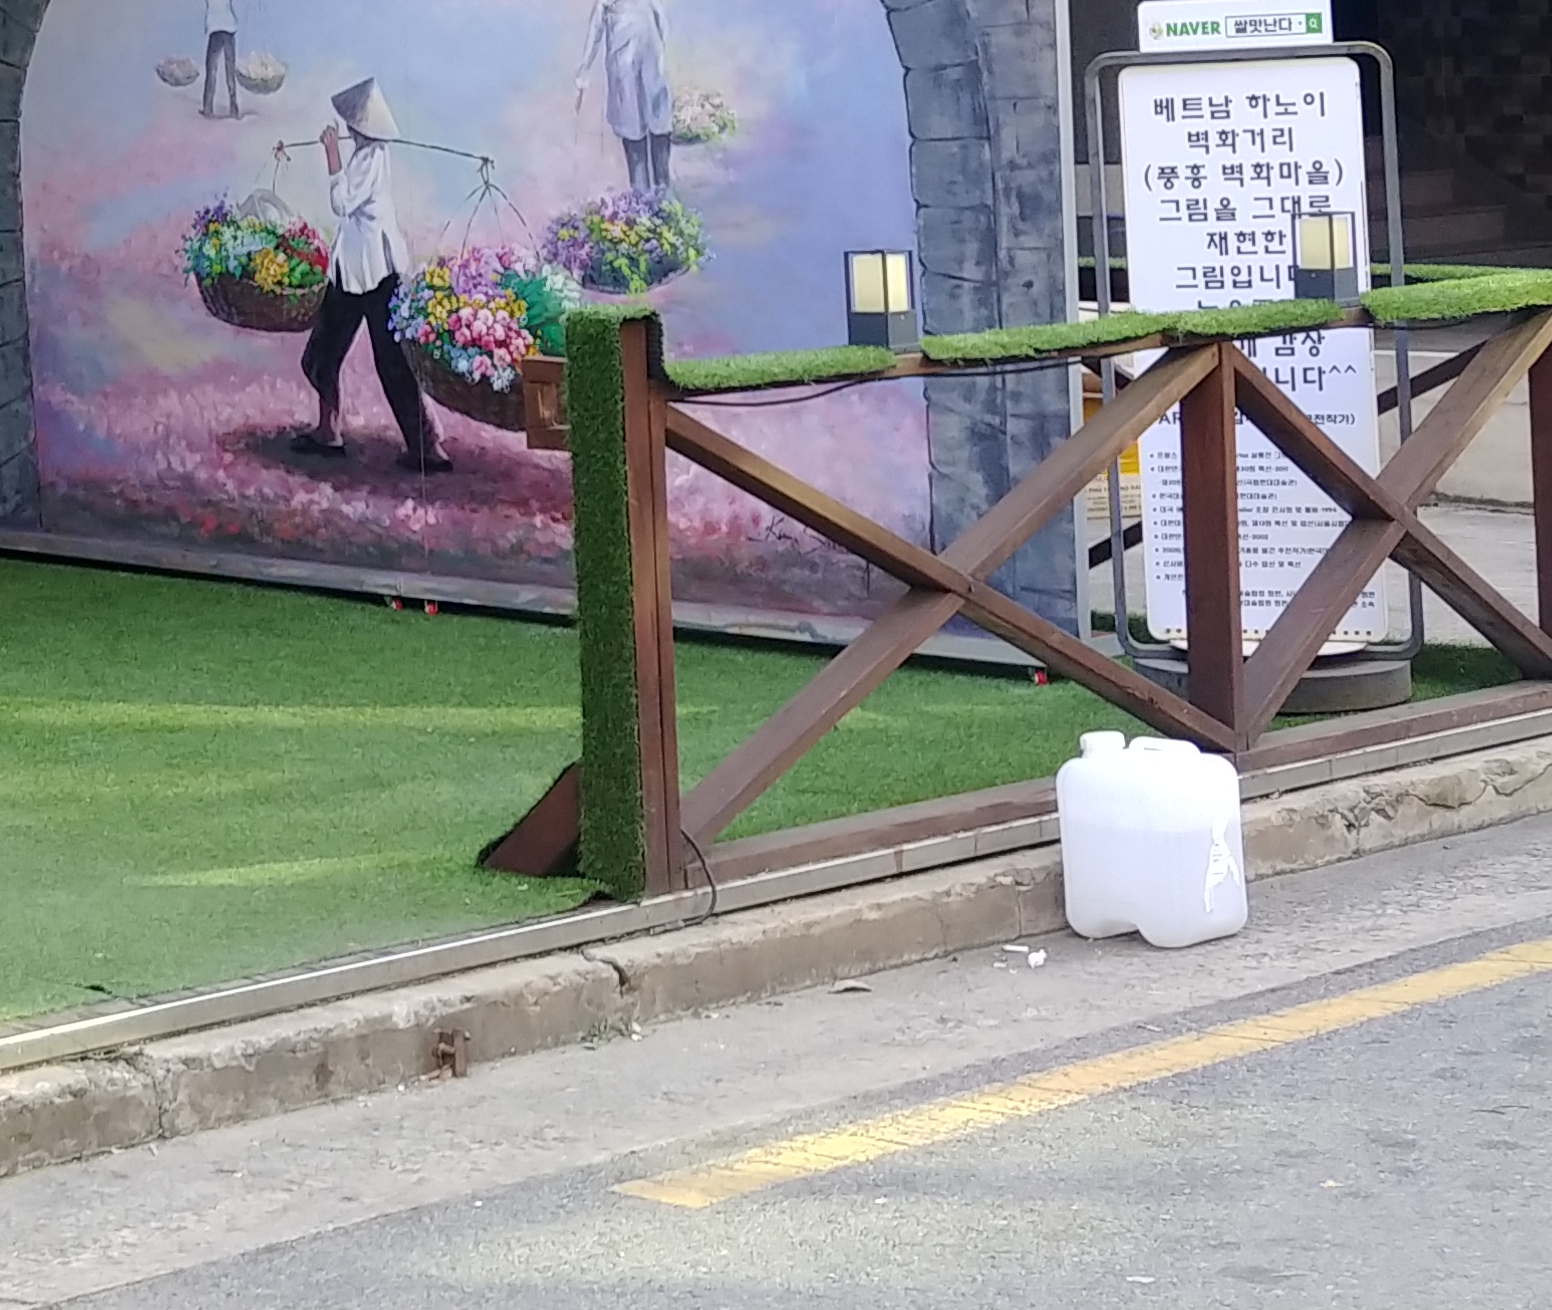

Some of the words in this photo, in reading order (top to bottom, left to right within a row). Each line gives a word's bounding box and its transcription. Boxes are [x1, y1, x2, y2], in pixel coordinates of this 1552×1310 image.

[1166, 20, 1221, 37] NAVER
[1233, 16, 1293, 34] 쌀맛난다
[1153, 95, 1233, 122] 베트남
[1246, 91, 1326, 119] 하노이
[1187, 127, 1294, 154] 벽화거리
[1143, 164, 1207, 191] (풍흥
[1222, 158, 1343, 187] 벽화마을)
[1159, 197, 1237, 222] 그림을
[1206, 229, 1287, 256] 재현한
